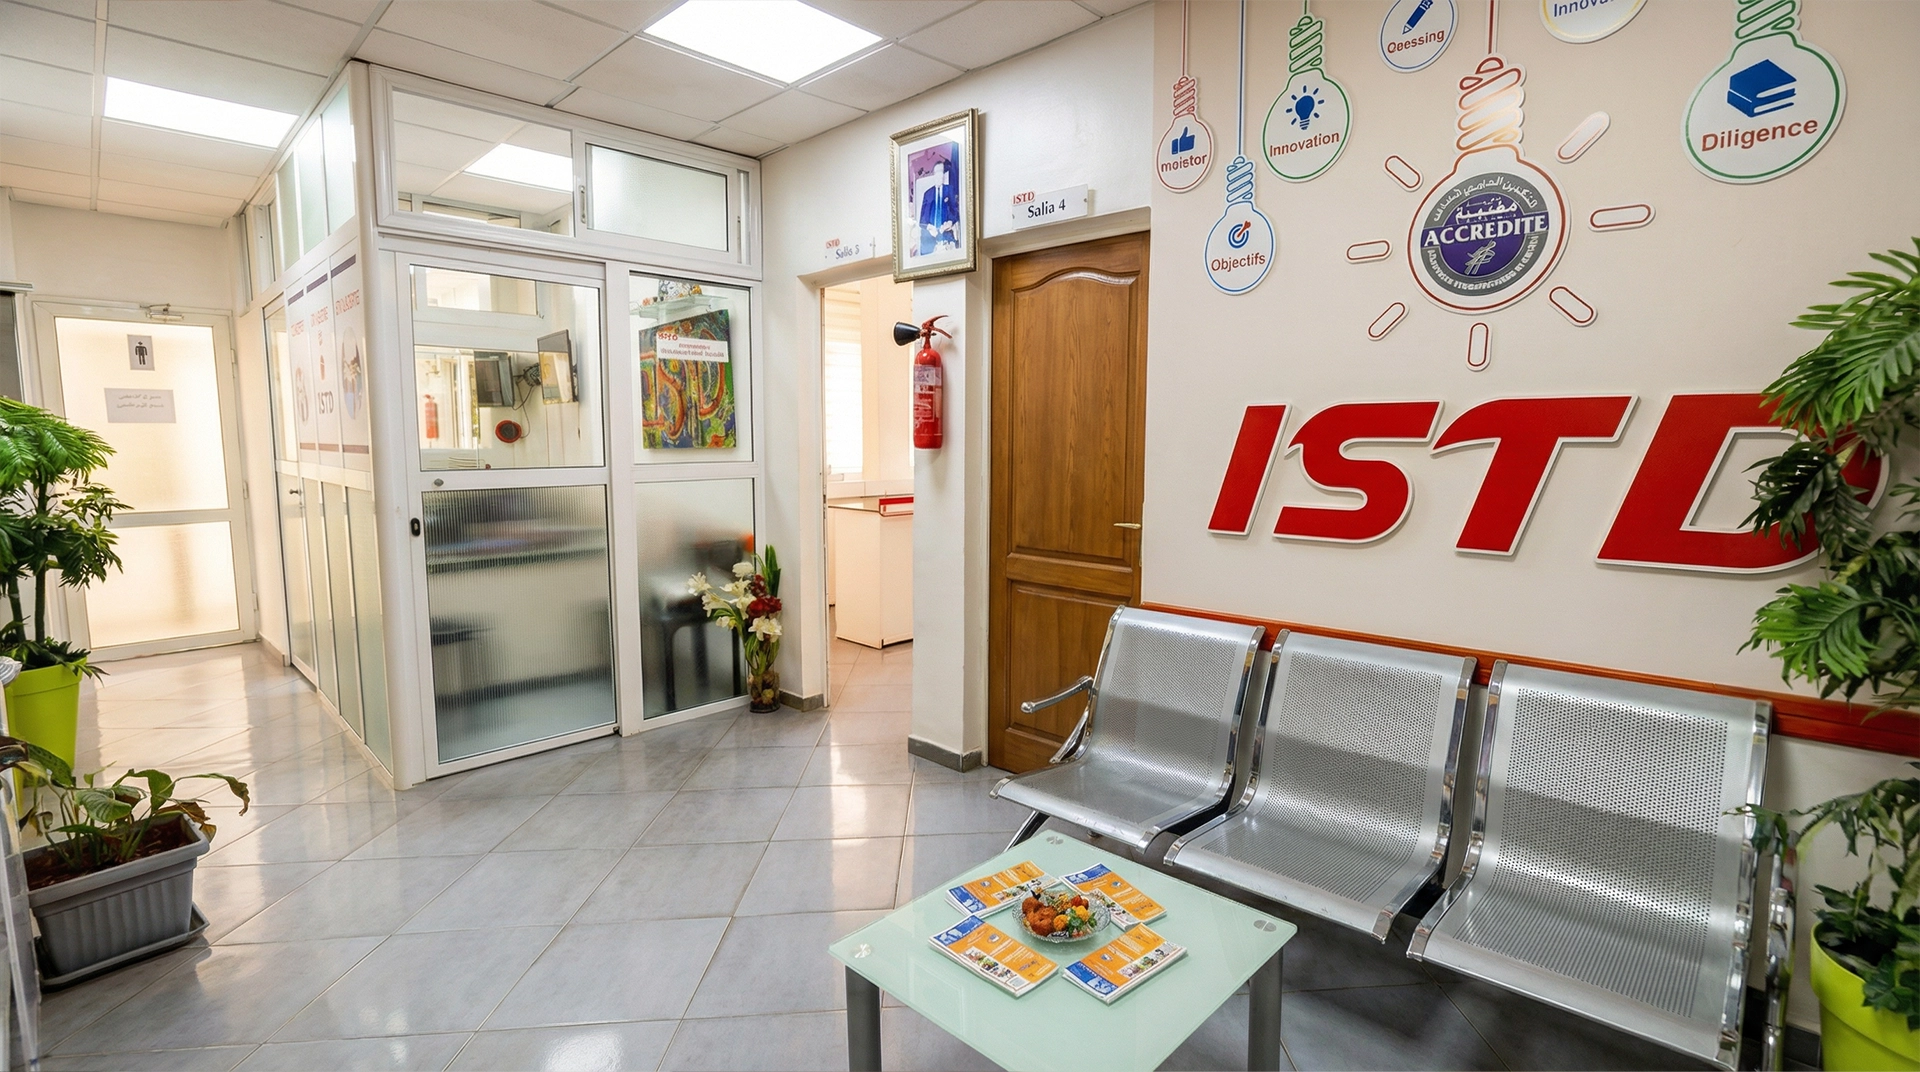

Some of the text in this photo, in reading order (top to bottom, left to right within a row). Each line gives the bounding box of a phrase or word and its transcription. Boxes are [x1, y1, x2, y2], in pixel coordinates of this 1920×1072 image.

[1554, 0, 1614, 17] Innov
[1269, 132, 1340, 157] Innovation
[1702, 119, 1818, 151] Diligence
[1161, 154, 1207, 172] moistor
[1028, 198, 1066, 218] Salia 4
[1423, 215, 1548, 247] ACCREDITE
[1211, 252, 1266, 272] Objectifs
[1207, 393, 1888, 574] ISTD
